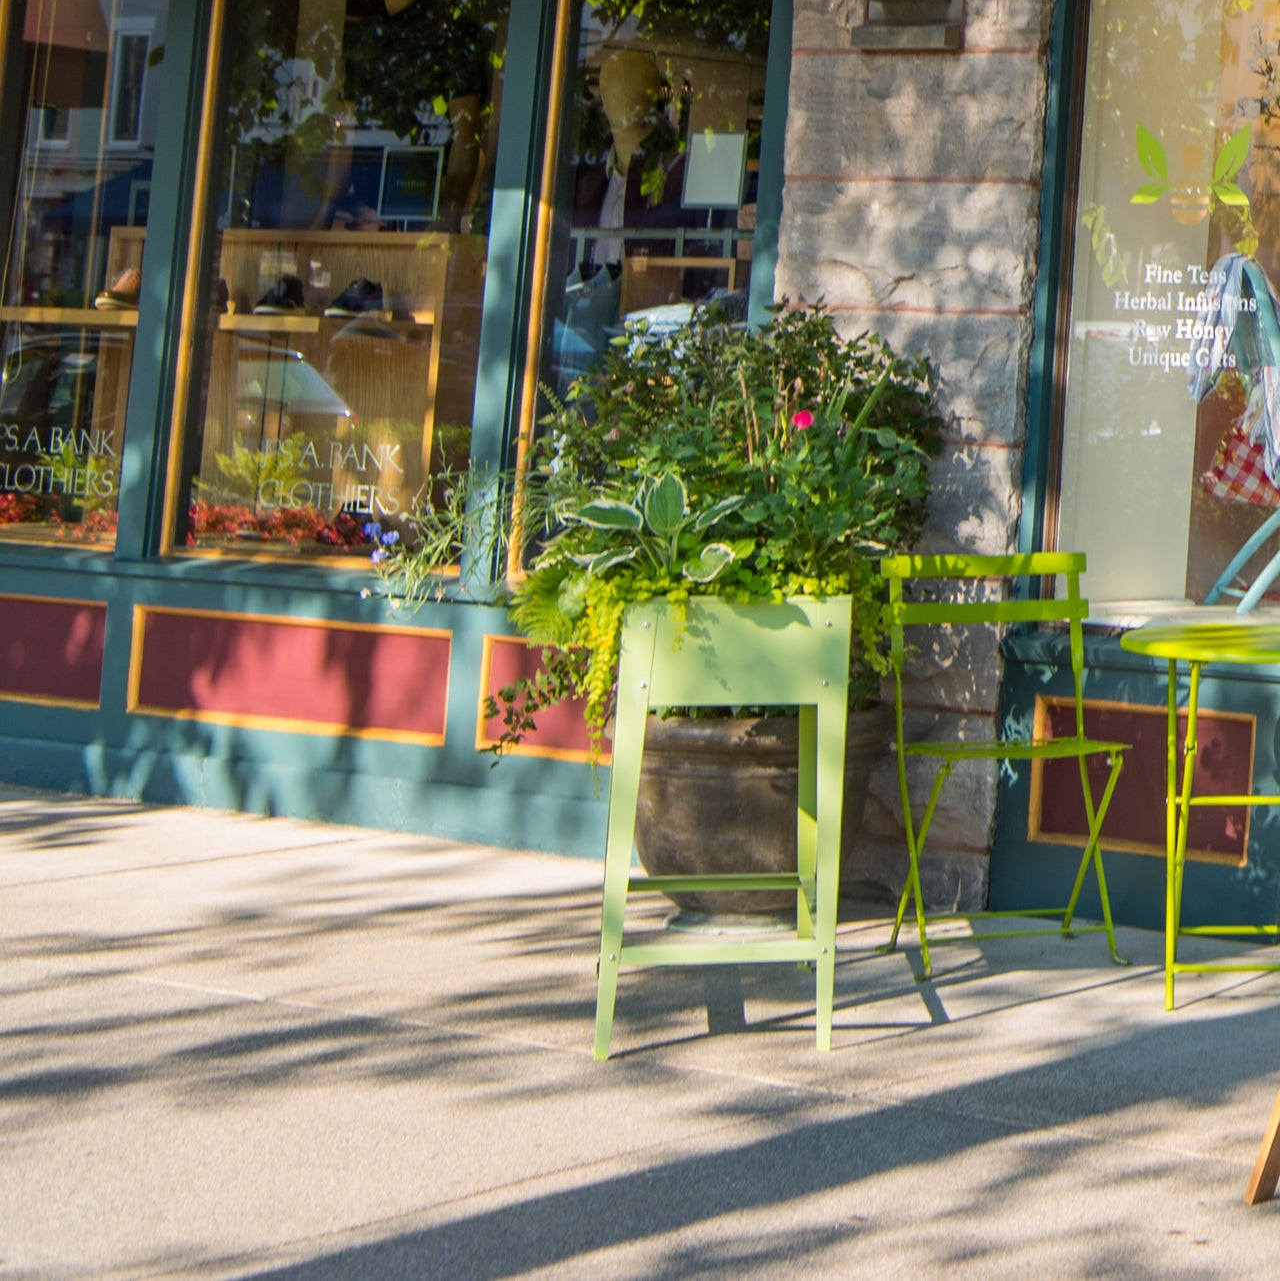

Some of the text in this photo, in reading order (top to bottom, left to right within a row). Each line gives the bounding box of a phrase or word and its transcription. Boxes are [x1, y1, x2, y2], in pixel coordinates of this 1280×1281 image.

[1144, 264, 1227, 284] Fine Teas
[1113, 291, 1172, 311] Herbal
[1176, 318, 1234, 347] Honey
[1128, 347, 1191, 373] Unique
[22, 425, 46, 452] A.
[50, 426, 116, 457] BANK
[299, 440, 325, 469] A.
[329, 441, 404, 474] BANK
[258, 477, 401, 517] CLOTHIERS
